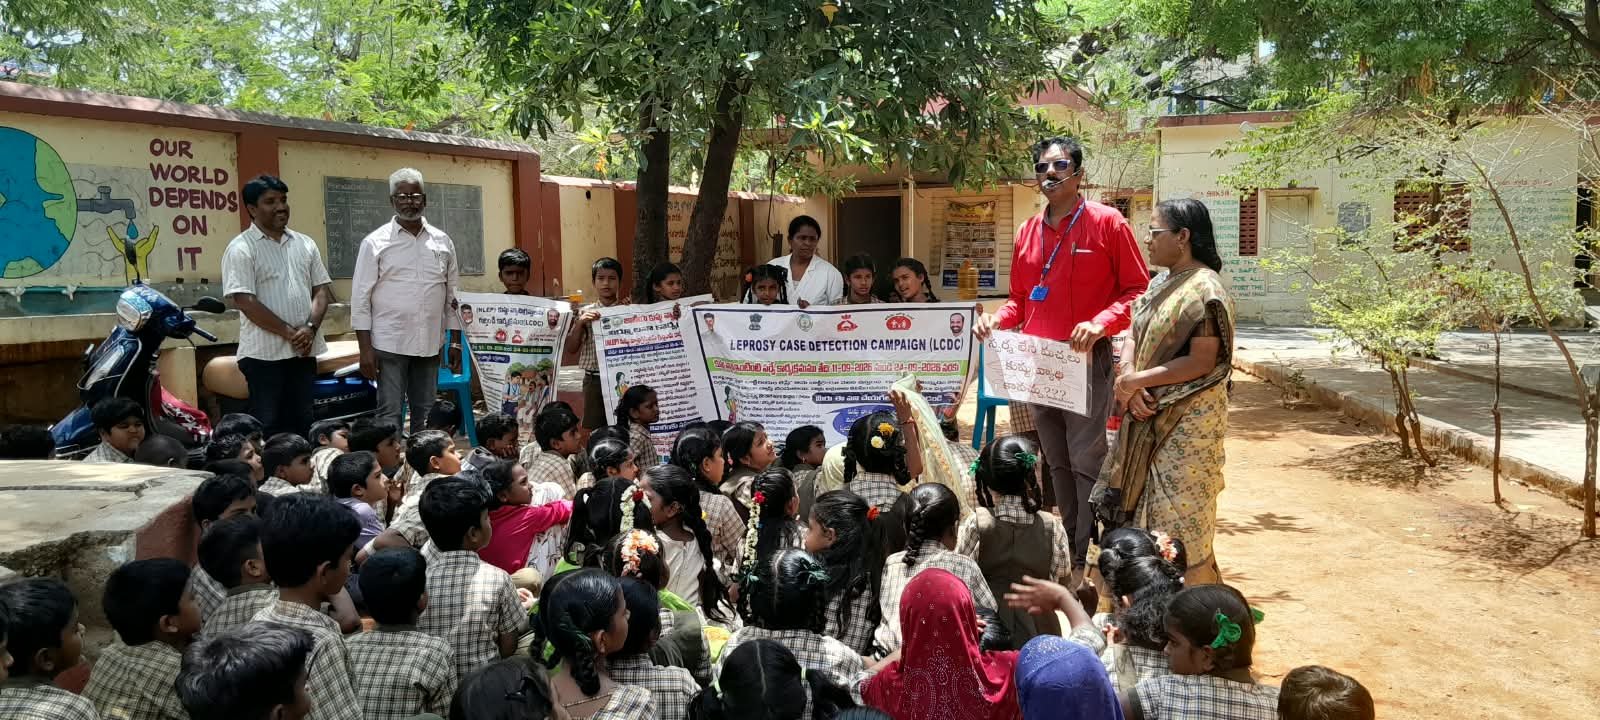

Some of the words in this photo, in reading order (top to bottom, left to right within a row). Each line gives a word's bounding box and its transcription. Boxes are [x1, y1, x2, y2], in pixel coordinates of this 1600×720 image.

[149, 138, 193, 159] OUR
[149, 162, 229, 185] WORLD
[148, 186, 238, 213] DEPENDS
[172, 214, 208, 236] ON
[177, 246, 202, 271] IT
[730, 339, 776, 351] LEPROSY
[779, 339, 806, 352] CASE
[809, 339, 868, 352] DETECTION
[870, 338, 926, 351] CAMPAIGN
[929, 337, 964, 352] (LCDC)
[1036, 366, 1064, 381] వ్యాధి
